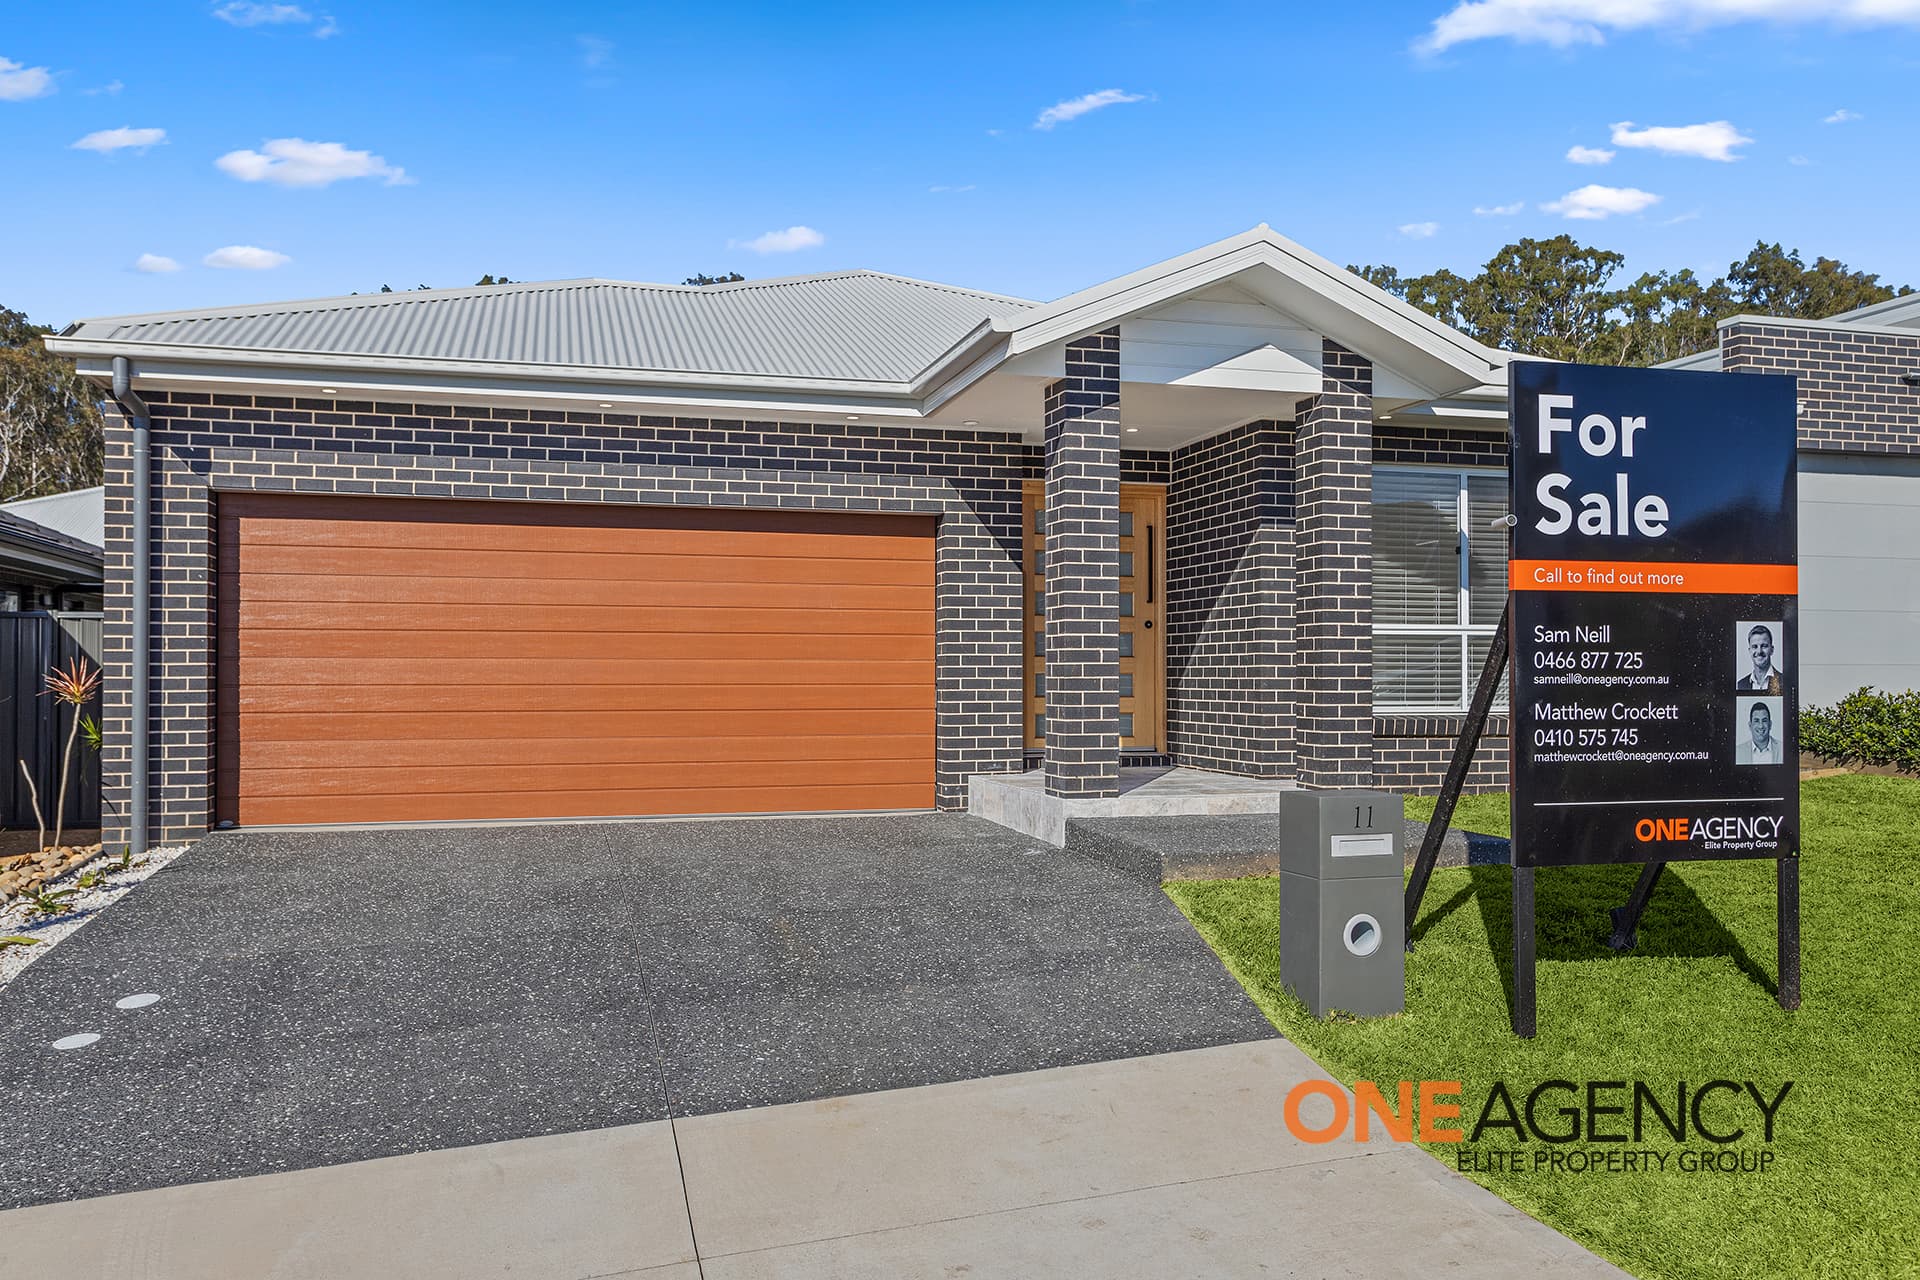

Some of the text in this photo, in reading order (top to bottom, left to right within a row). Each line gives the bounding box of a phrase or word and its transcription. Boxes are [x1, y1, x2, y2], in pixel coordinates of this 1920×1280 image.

[1537, 394, 1646, 457] For
[1535, 473, 1669, 537] Sale
[1533, 567, 1684, 585] Call to find out more
[1534, 624, 1610, 643] Sam Neill
[1533, 651, 1643, 669] 0466 877 725
[1533, 673, 1669, 687] samneill@oneagency.com.au
[1534, 702, 1679, 720] Matthew Crockett
[1534, 728, 1639, 746] 0410 575 745
[1534, 750, 1709, 763] matthewcrockett@oneagency.com.au
[1354, 805, 1374, 829] 11
[1704, 840, 1778, 850] Elite Property Group
